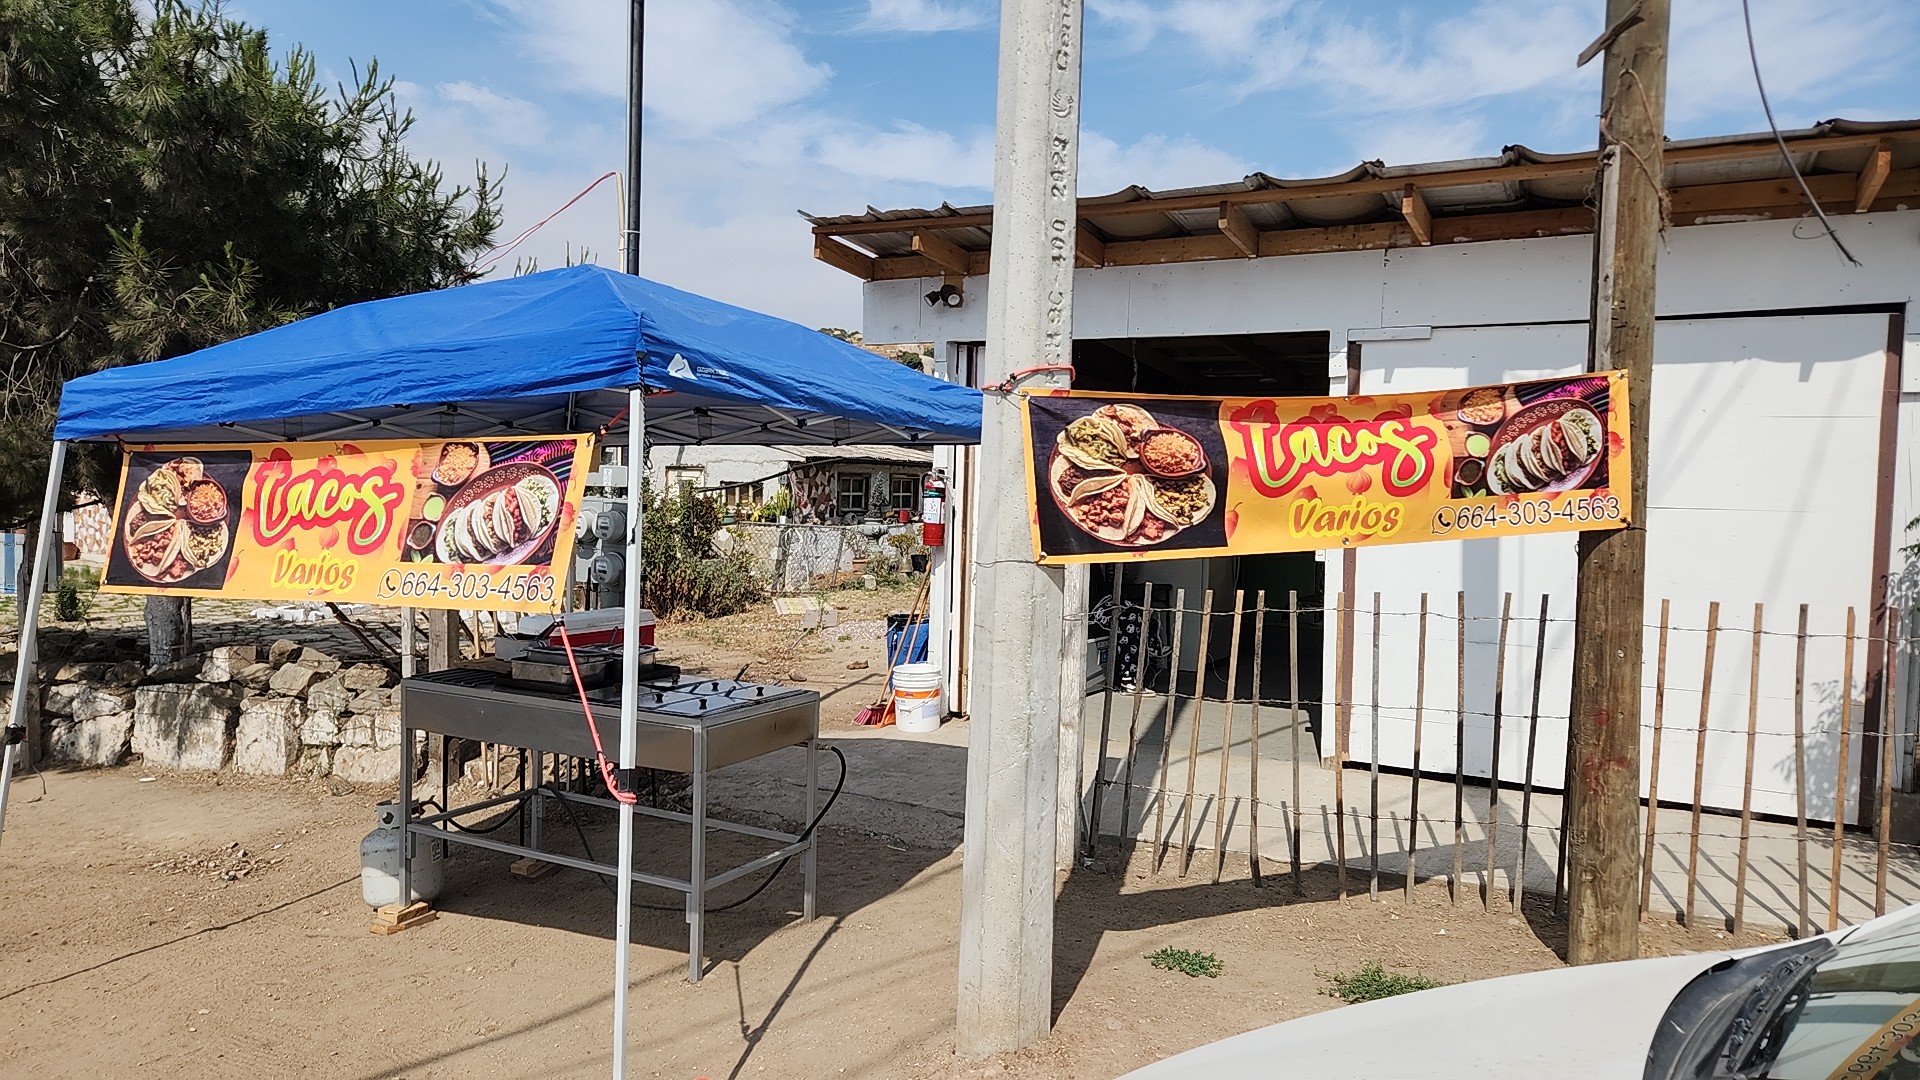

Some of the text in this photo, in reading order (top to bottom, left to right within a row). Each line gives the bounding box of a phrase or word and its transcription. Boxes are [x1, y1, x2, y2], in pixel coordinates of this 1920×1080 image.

[1291, 497, 1402, 535] Varios
[1456, 496, 1621, 530] 664-303-4563
[272, 552, 356, 591] Varios
[400, 571, 556, 602] 664-303-4563
